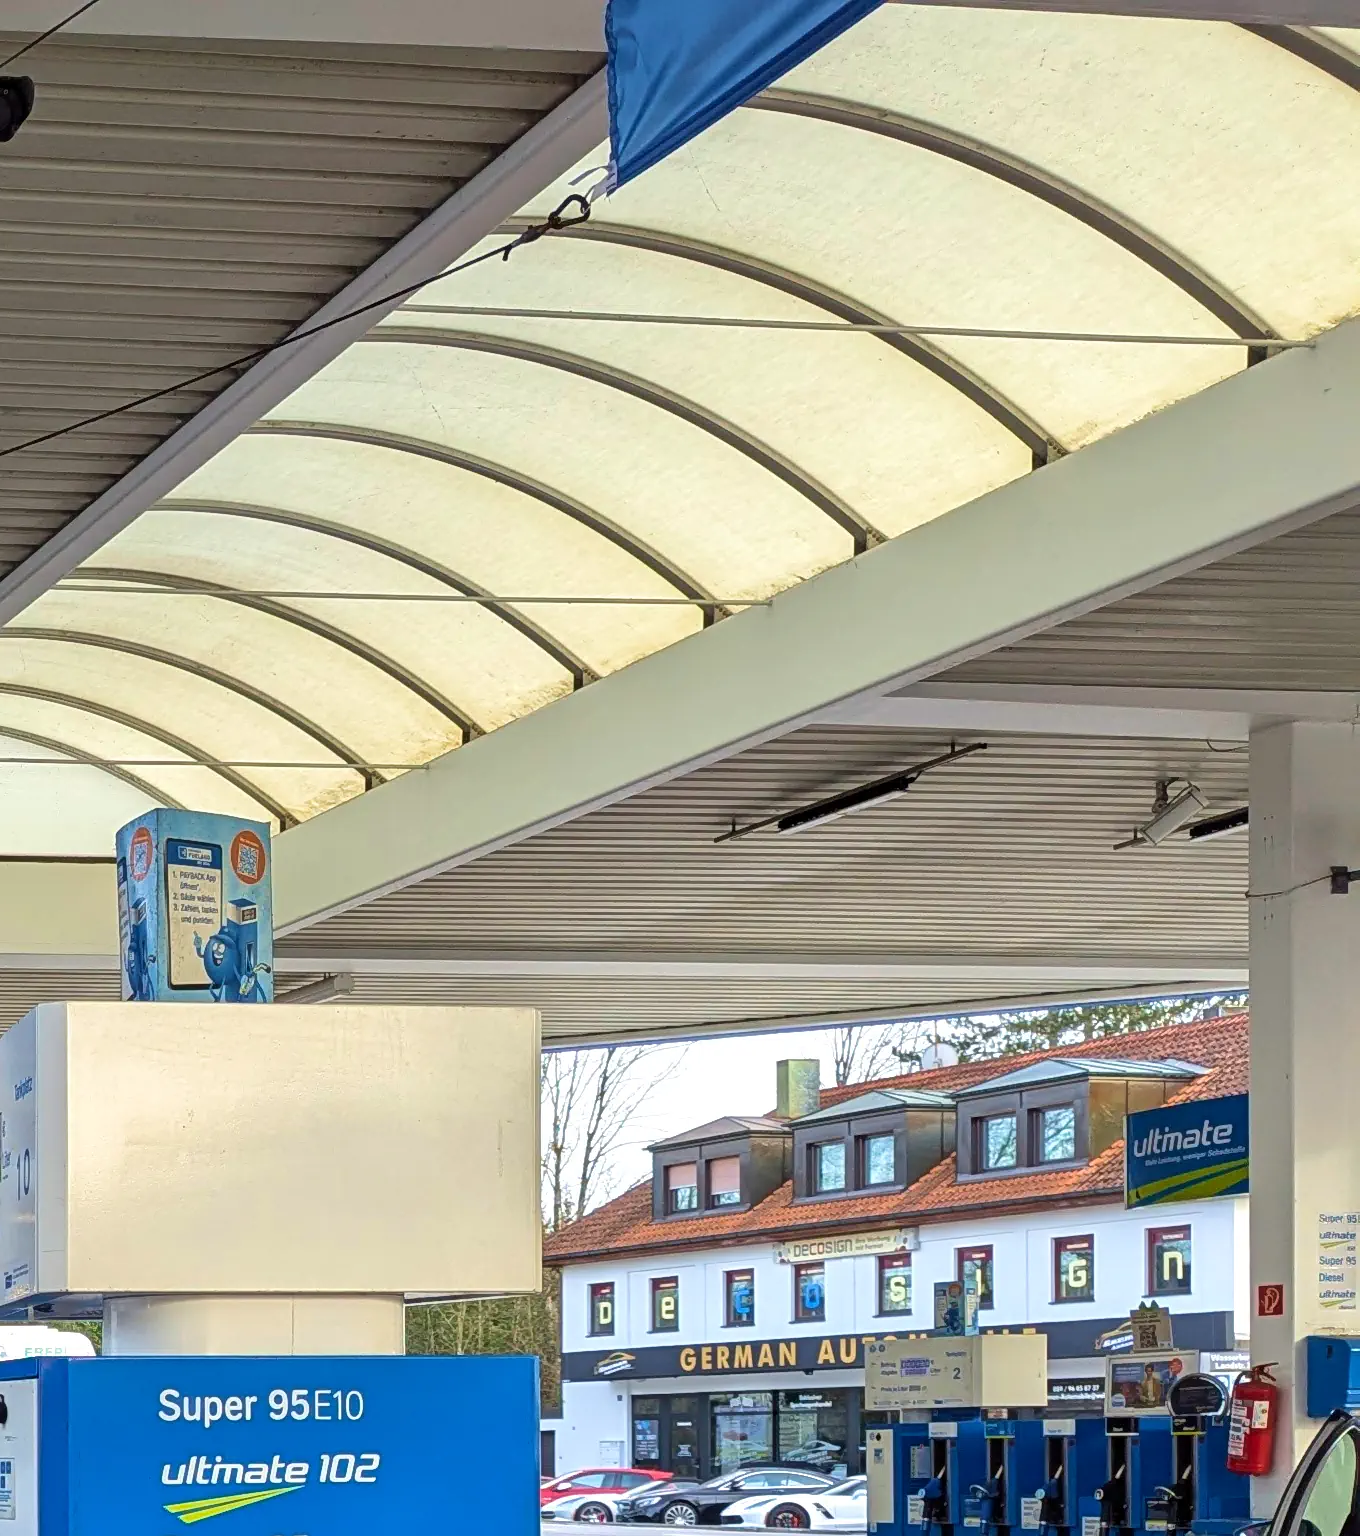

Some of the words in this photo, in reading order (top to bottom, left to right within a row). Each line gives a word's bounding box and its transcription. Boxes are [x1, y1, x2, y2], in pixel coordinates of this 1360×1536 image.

[206, 873, 217, 883] App
[1133, 1119, 1233, 1158] ultimate
[16, 1147, 31, 1201] 10
[1319, 1213, 1344, 1225] Super
[1319, 1231, 1356, 1240] ultimate
[1319, 1256, 1343, 1267] Super
[1346, 1256, 1357, 1265] 95
[1068, 1258, 1088, 1288] G
[1319, 1273, 1344, 1282] Diesel
[1319, 1289, 1356, 1299] ultimate
[679, 1342, 797, 1372] GERMAN
[952, 1367, 961, 1380] 2
[158, 1388, 258, 1428] Super
[161, 1454, 309, 1486] ultimate
[318, 1453, 381, 1484] 102
